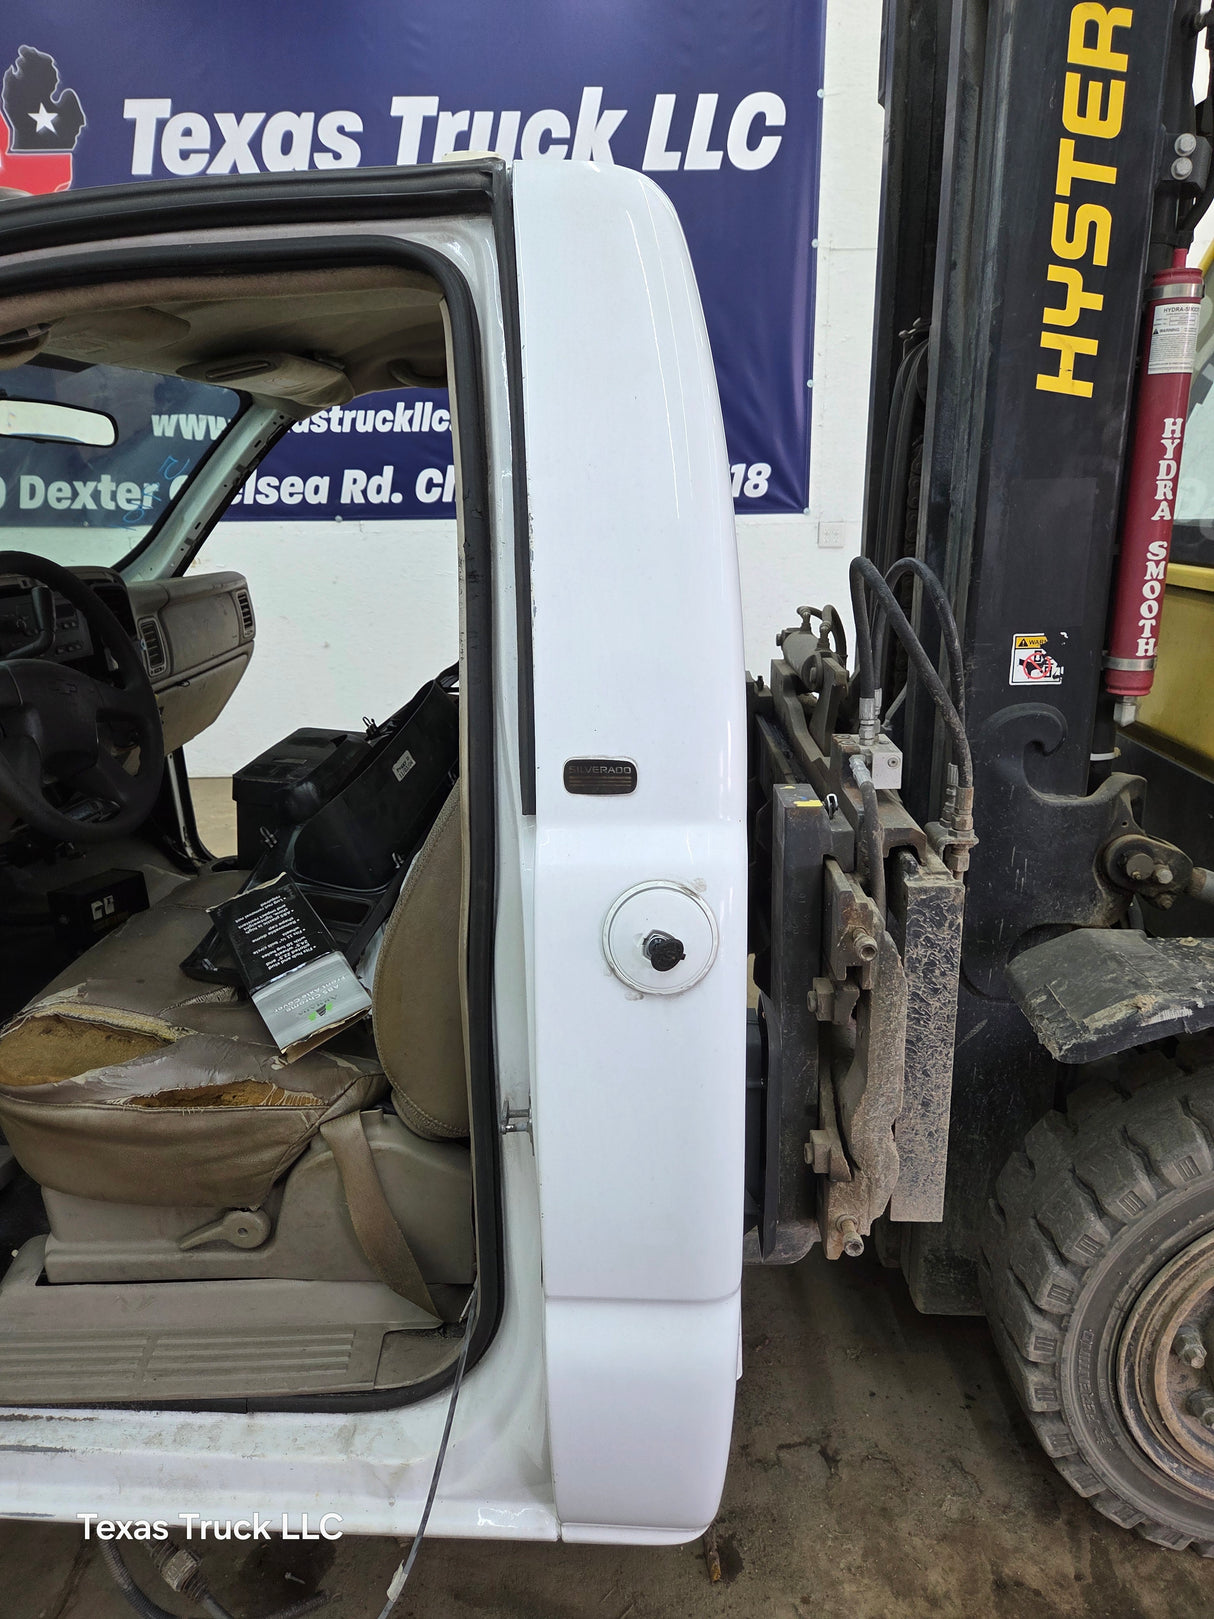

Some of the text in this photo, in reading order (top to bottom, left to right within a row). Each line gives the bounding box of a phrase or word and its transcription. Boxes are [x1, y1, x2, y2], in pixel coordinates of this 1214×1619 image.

[123, 86, 787, 176] Texas Truck LLC
[1035, 1, 1133, 398] HYSTER
[19, 474, 160, 511] Dexter
[340, 465, 403, 504] Rd.
[1136, 418, 1184, 656] HYDRA SMOOTH
[568, 765, 632, 774] SILVERADO
[275, 976, 345, 1012] Front Axle Cover
[286, 984, 338, 1011] ABS Chrome
